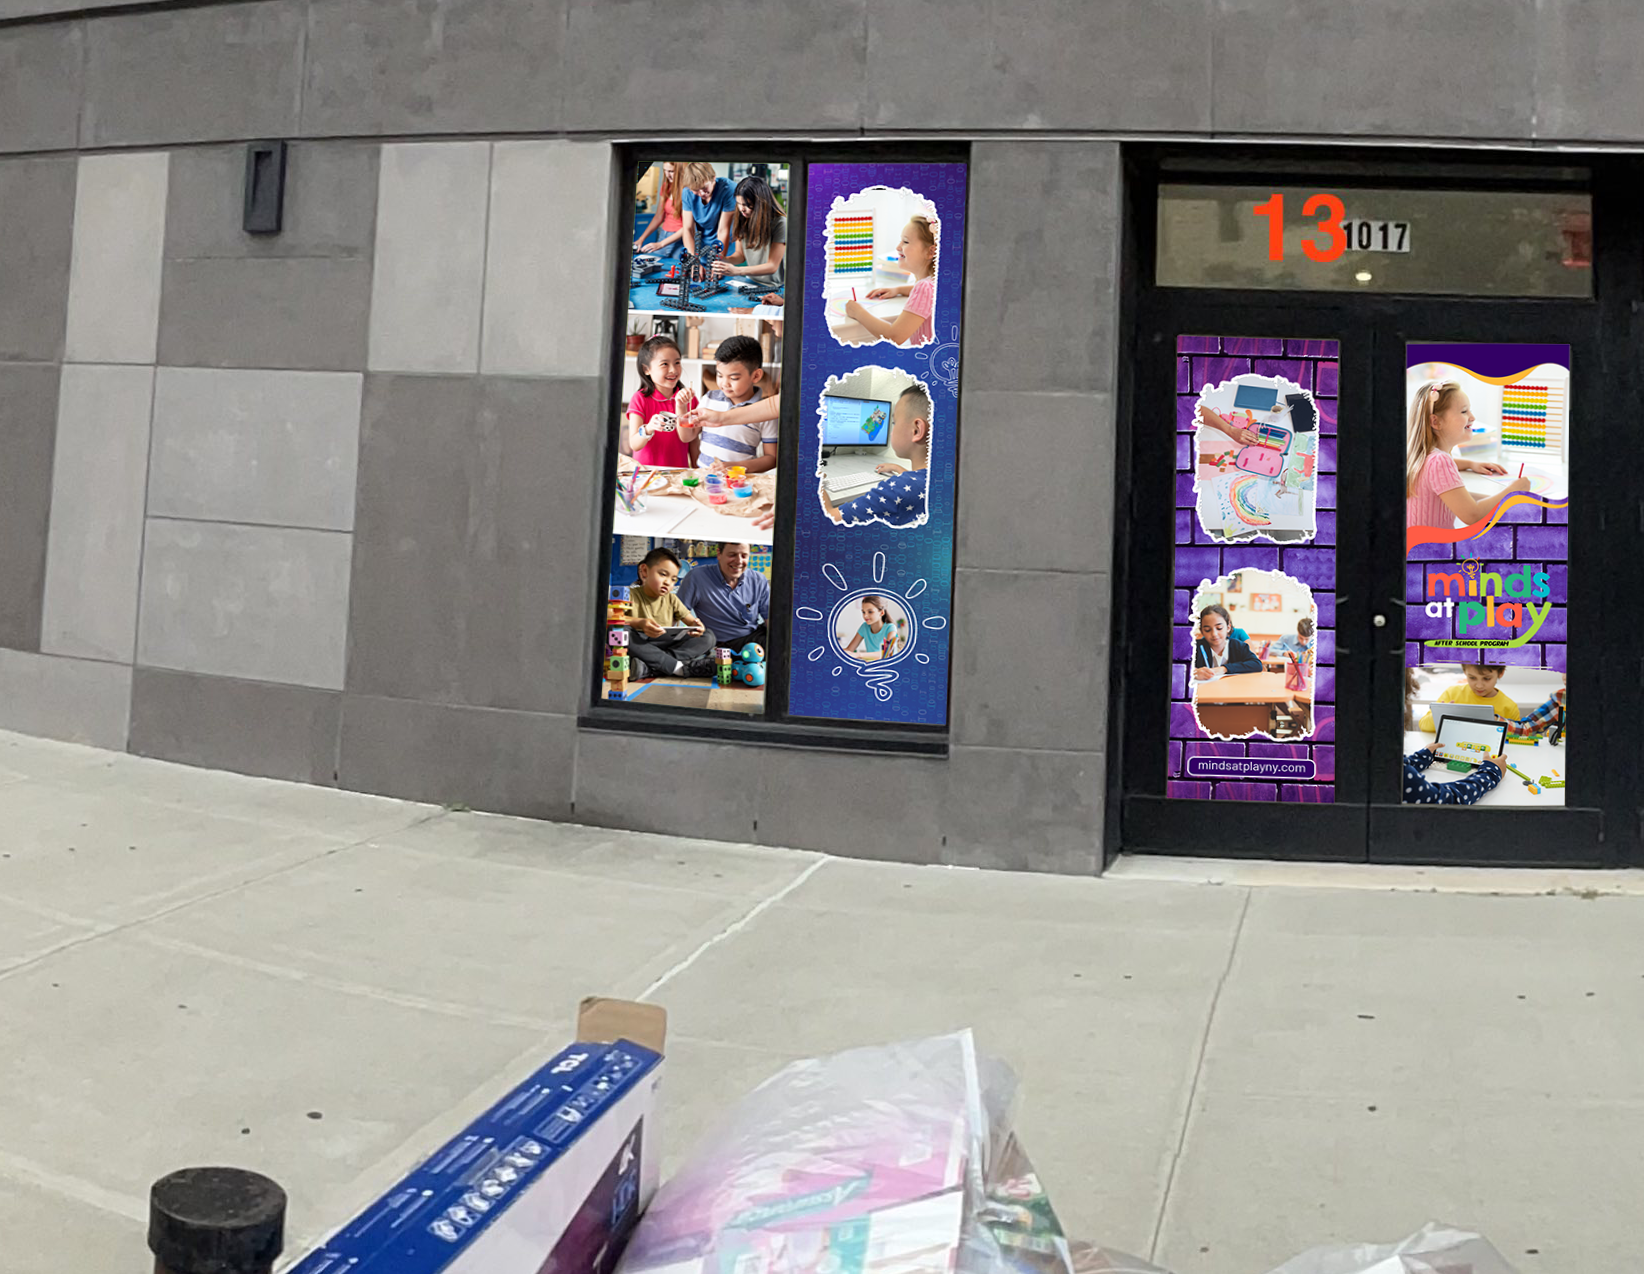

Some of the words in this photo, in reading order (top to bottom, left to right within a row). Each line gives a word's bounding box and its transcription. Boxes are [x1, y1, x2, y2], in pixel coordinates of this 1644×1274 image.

[1342, 221, 1408, 251] 1017
[1427, 564, 1551, 598] minds
[1425, 597, 1455, 618] at
[1458, 595, 1553, 640] play
[1198, 760, 1306, 774] mindsatplayny.com
[550, 1052, 589, 1074] TCL
